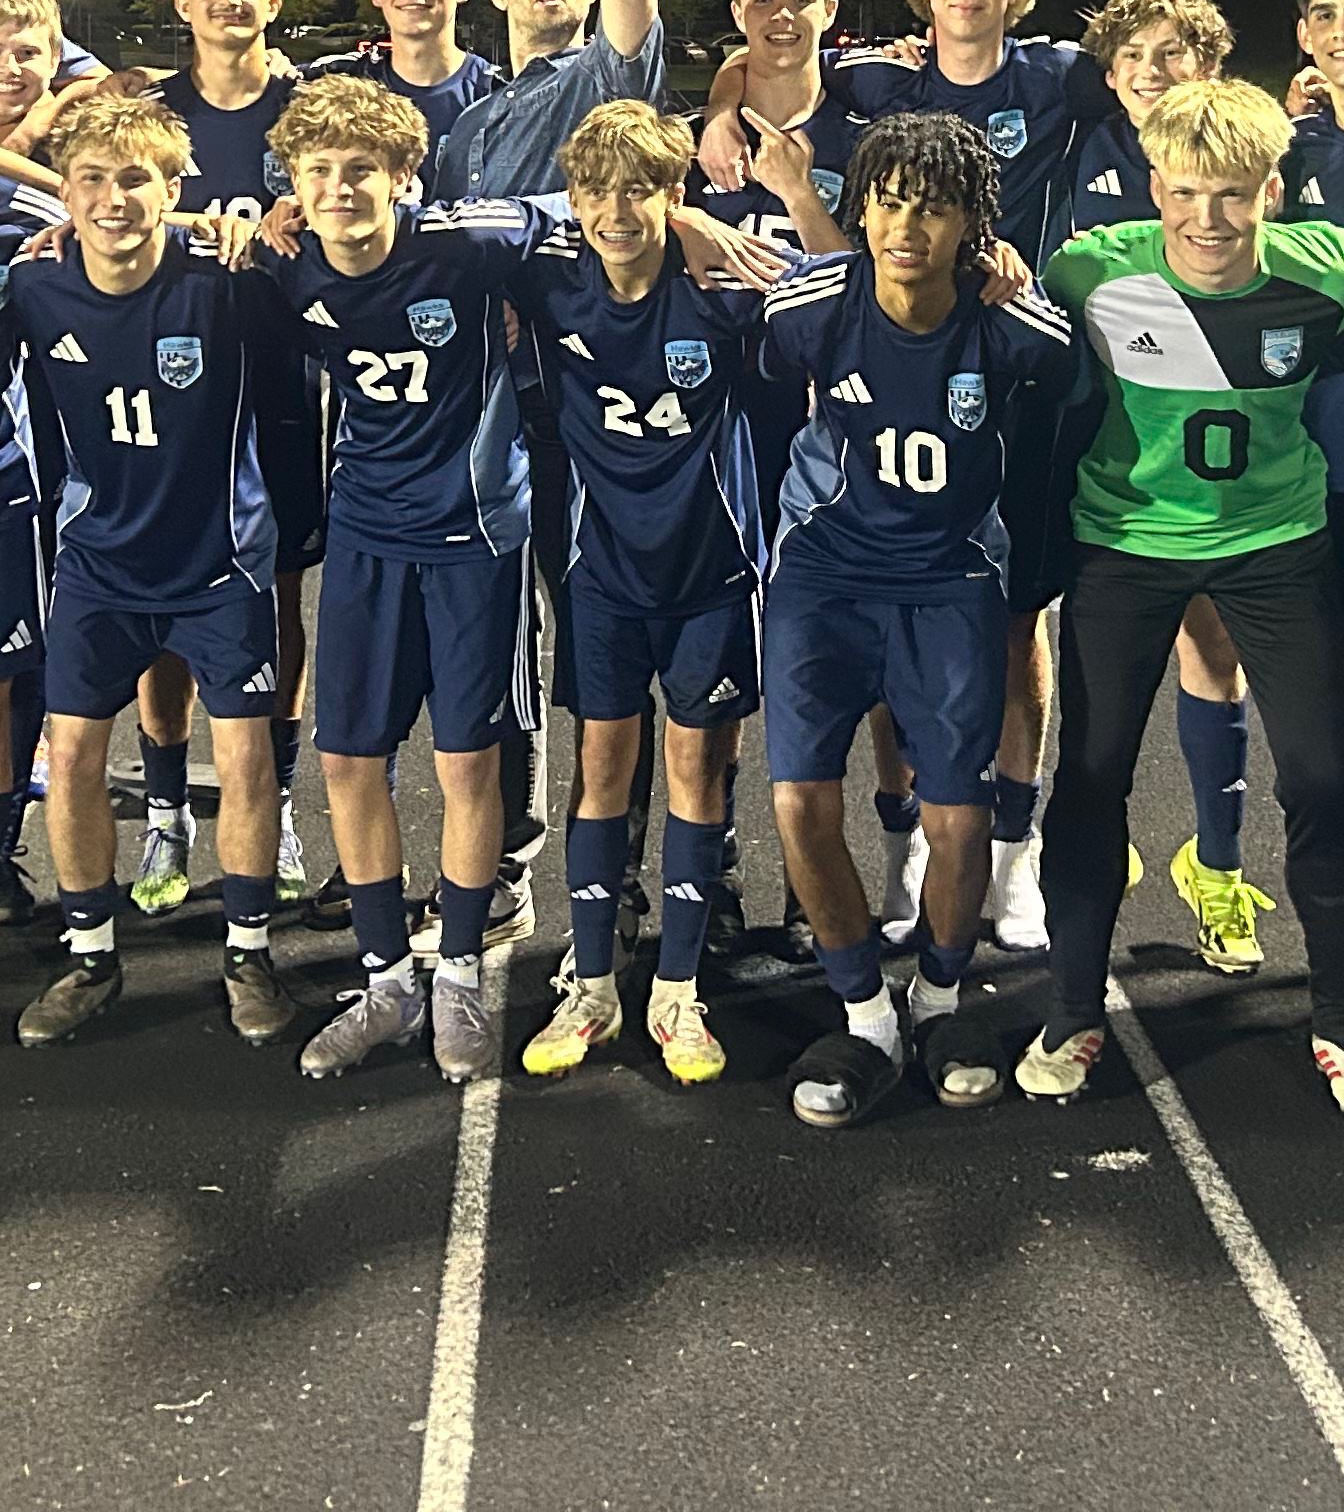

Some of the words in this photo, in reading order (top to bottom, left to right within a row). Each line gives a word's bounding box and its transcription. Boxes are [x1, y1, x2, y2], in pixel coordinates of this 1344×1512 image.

[347, 349, 430, 403] 27
[1127, 345, 1164, 356] adidas
[106, 387, 158, 447] 11
[597, 386, 692, 437] 24
[876, 428, 947, 493] 10
[1183, 408, 1251, 481] 0
